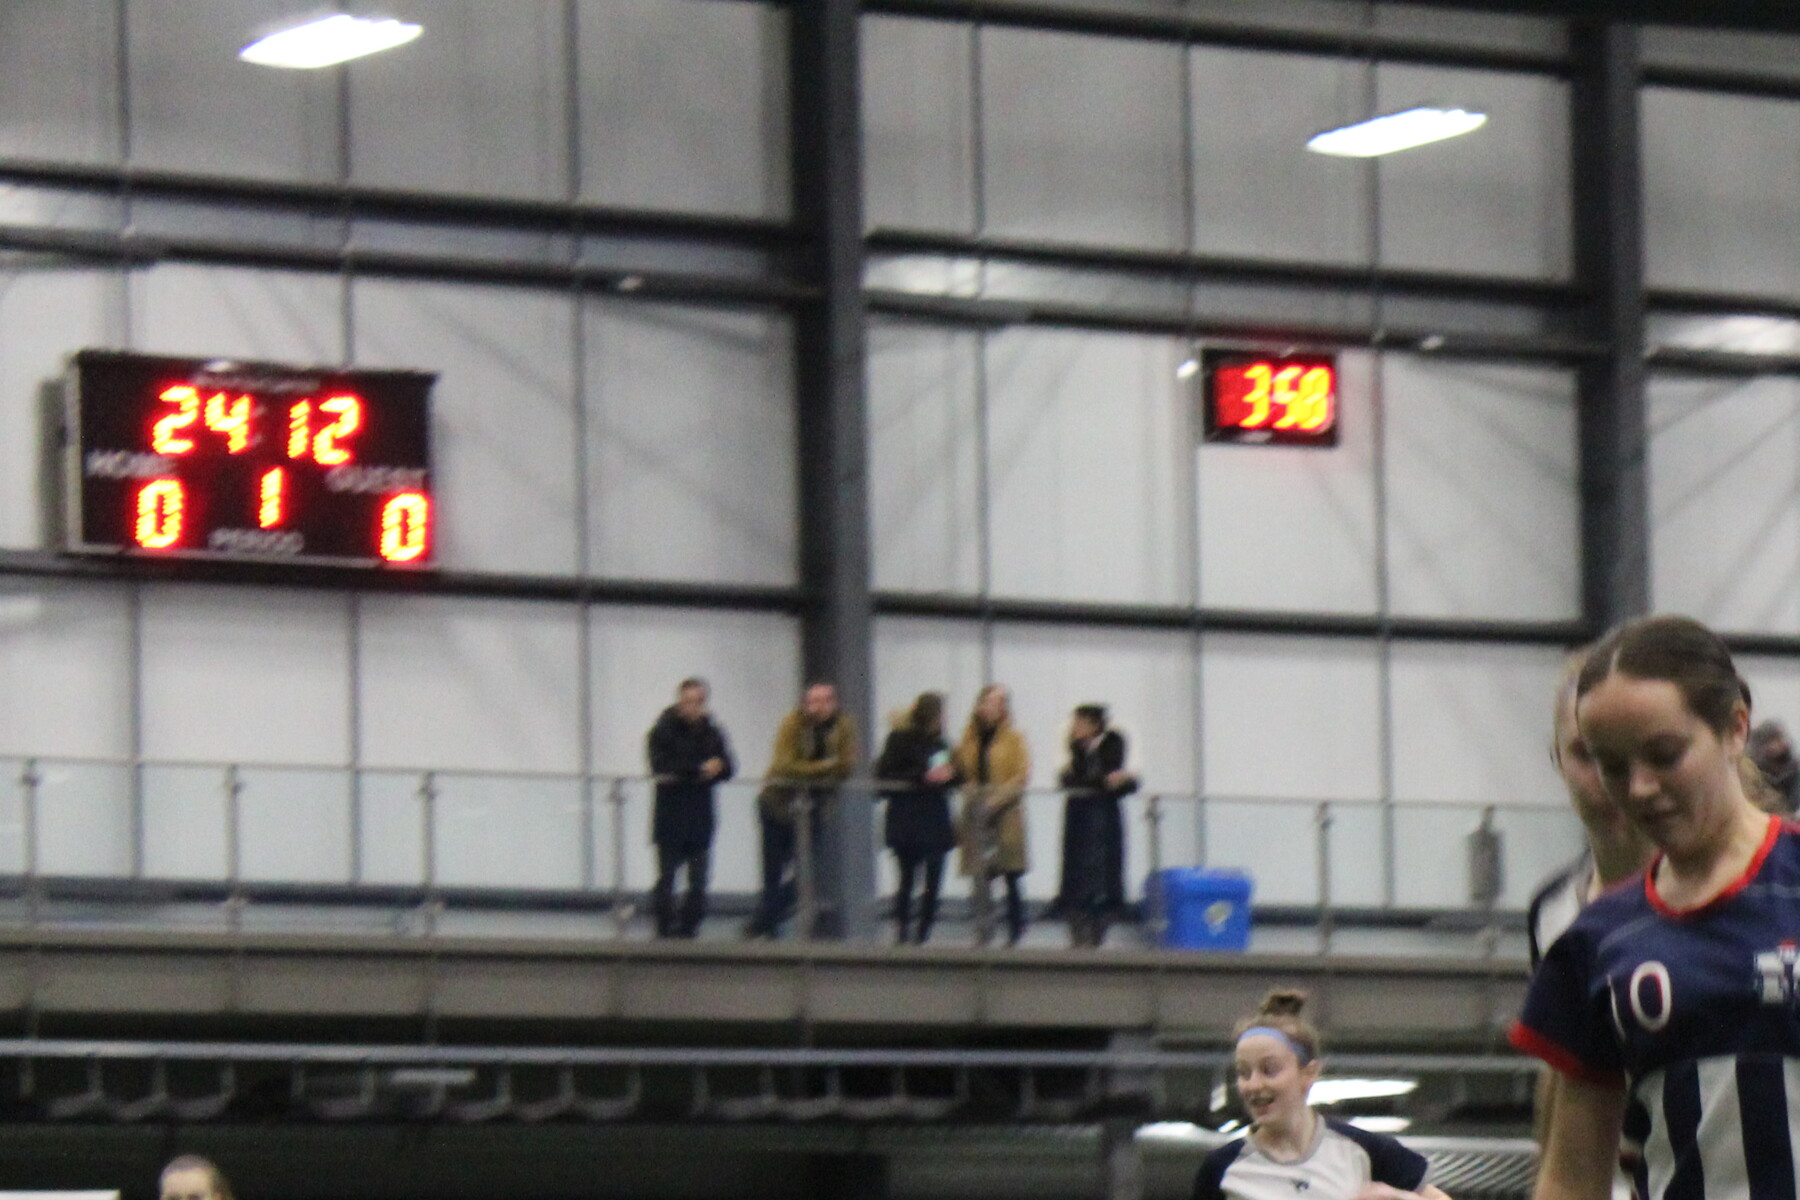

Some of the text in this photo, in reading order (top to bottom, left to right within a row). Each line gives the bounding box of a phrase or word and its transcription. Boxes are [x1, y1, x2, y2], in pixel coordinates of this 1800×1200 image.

[135, 477, 185, 549] 0
[257, 466, 283, 529] 1
[379, 491, 430, 563] 0
